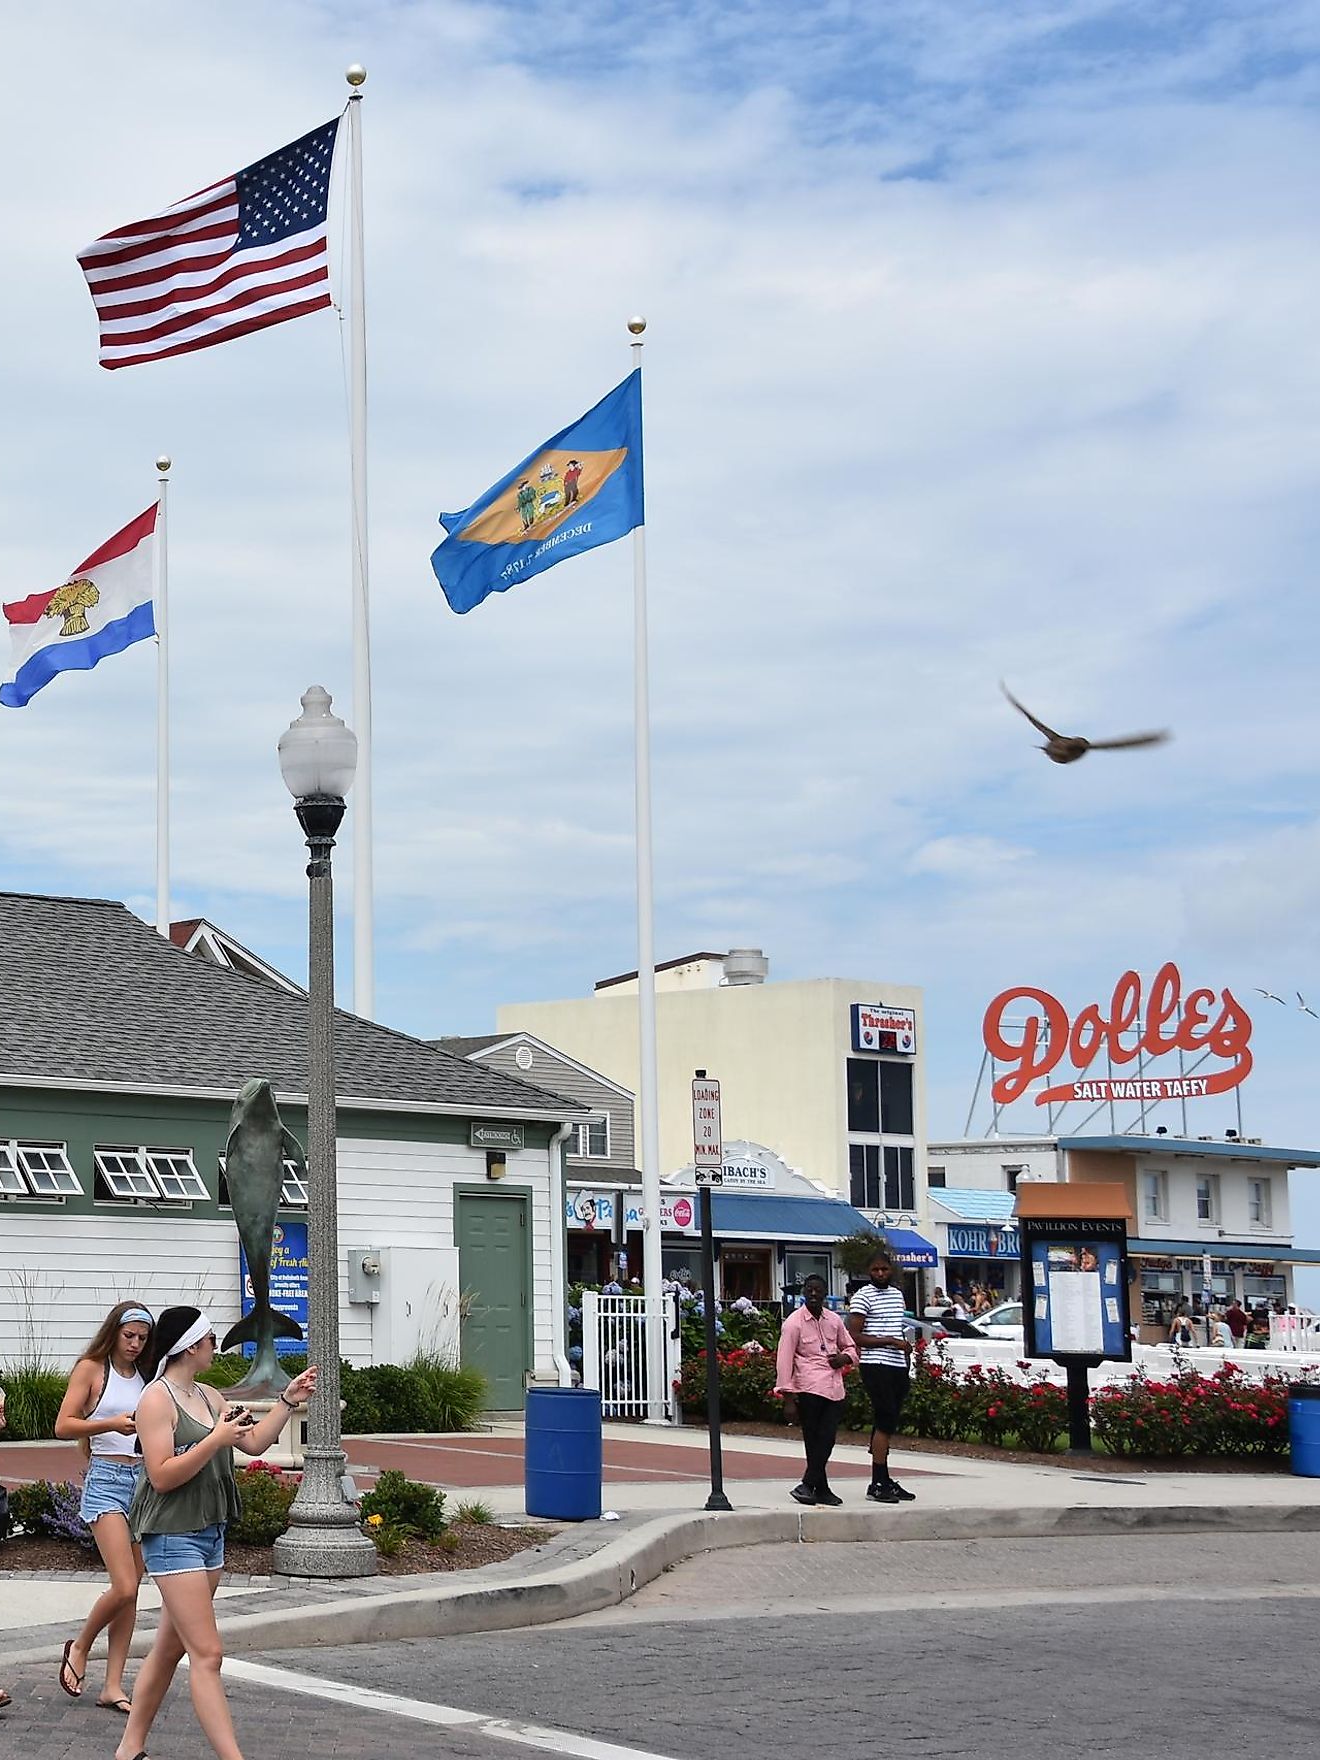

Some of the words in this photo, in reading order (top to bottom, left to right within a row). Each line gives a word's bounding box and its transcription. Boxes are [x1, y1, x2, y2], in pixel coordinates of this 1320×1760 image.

[694, 1089, 719, 1101] LOADING
[1073, 1081, 1107, 1099] SALT
[1110, 1080, 1161, 1098] WATER
[1164, 1079, 1209, 1096] TAFFY
[699, 1108, 715, 1119] ZONE
[703, 1126, 712, 1138] 20
[723, 1165, 767, 1179] IBACH'S
[949, 1229, 988, 1252] KOHR
